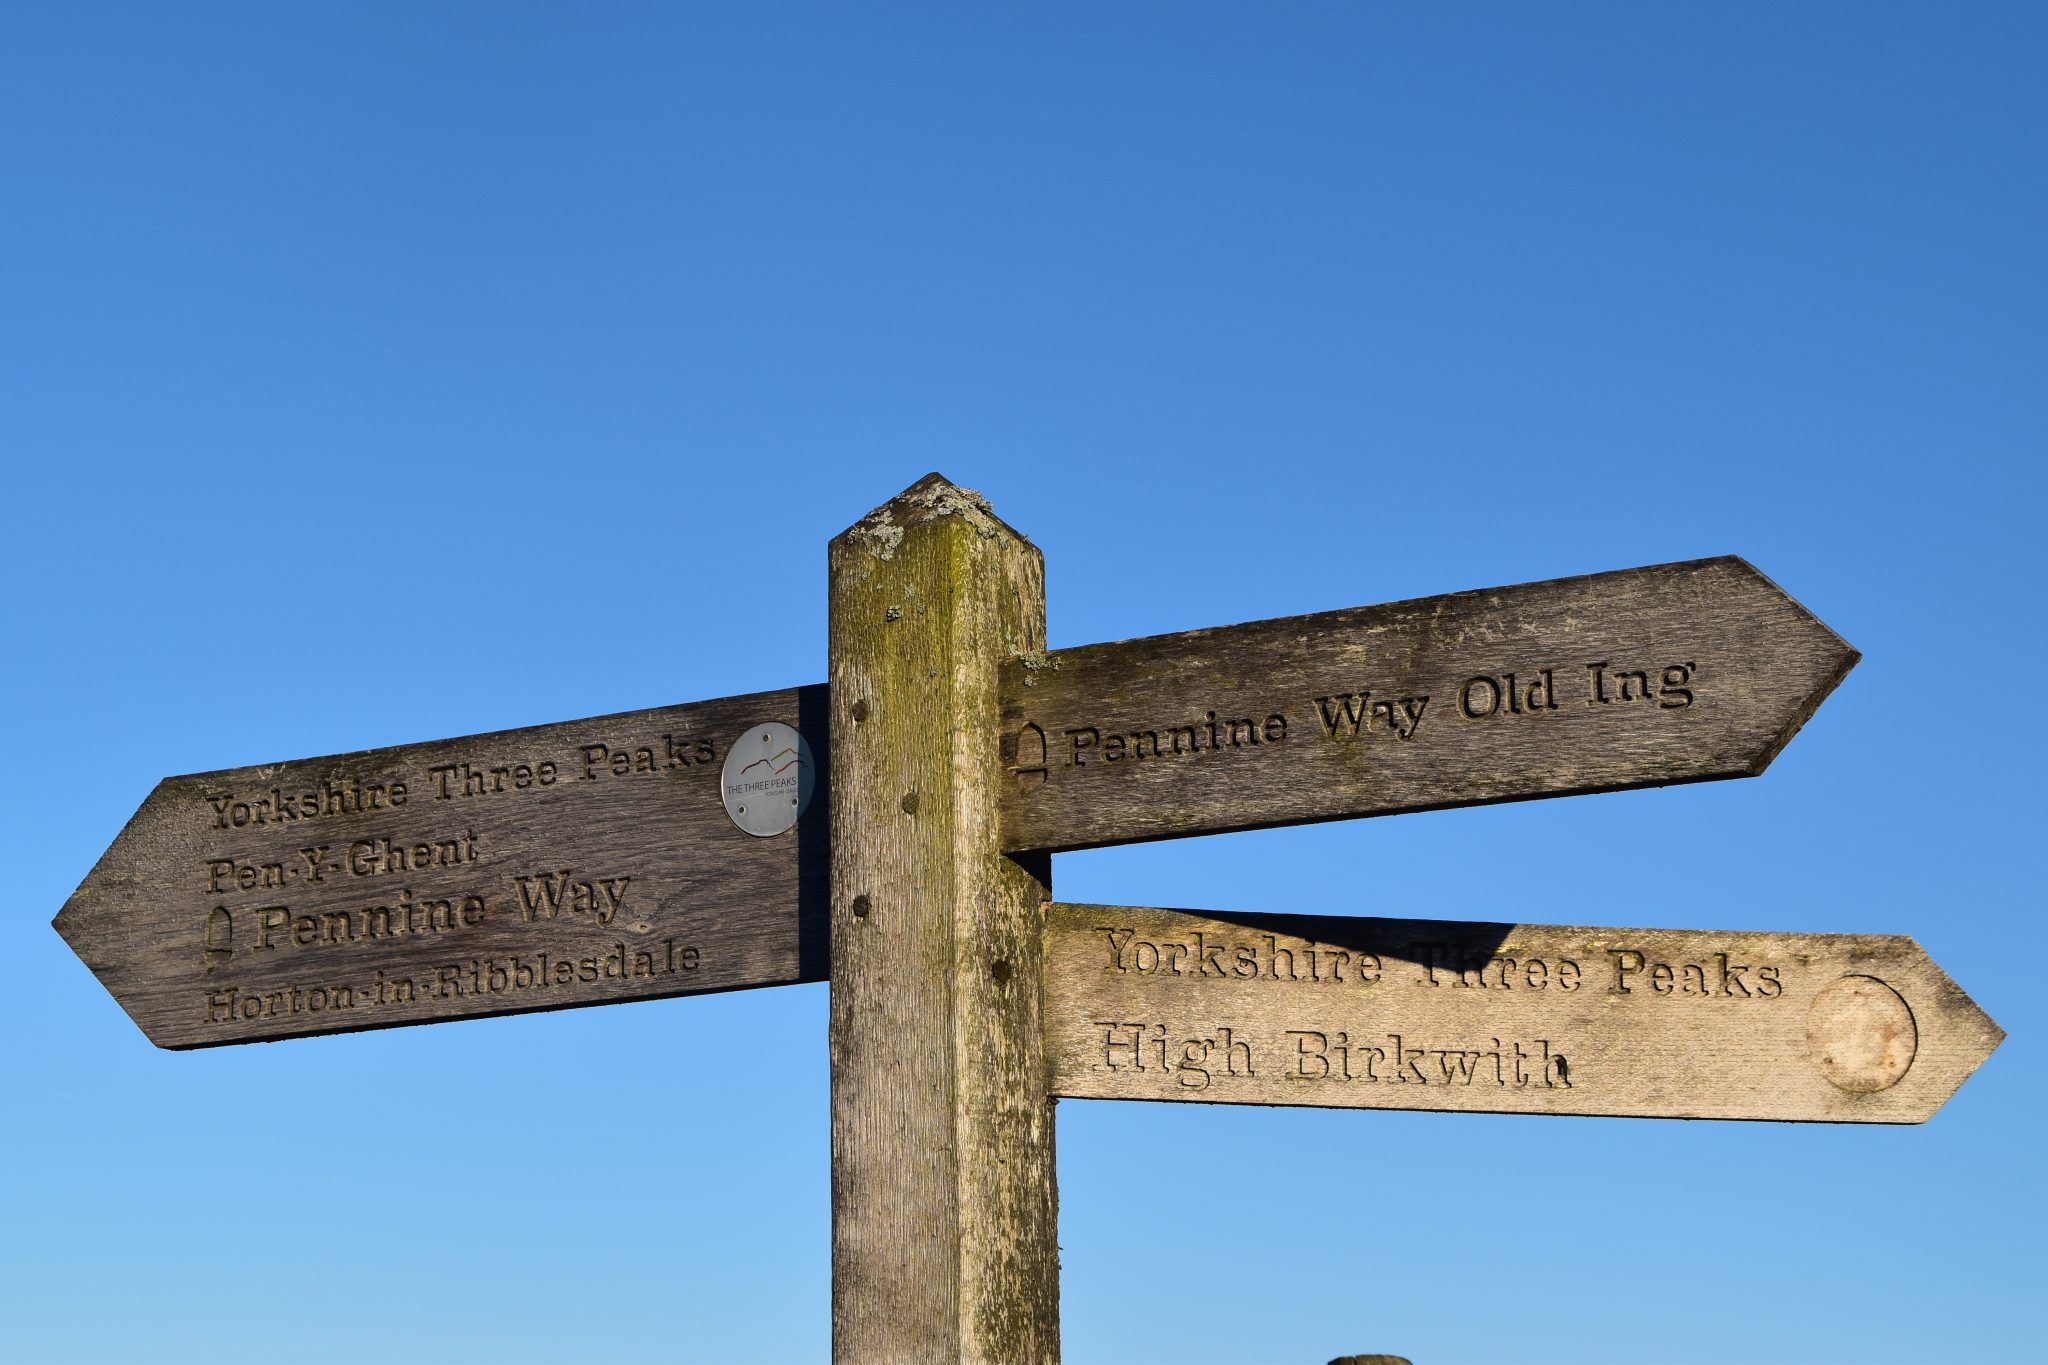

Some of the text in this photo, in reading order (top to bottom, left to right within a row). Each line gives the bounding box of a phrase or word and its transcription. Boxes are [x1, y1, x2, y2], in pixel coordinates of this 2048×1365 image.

[1062, 661, 1697, 768] Pennine Way Old Ing
[205, 733, 716, 830] Yorkshire Three Peaks
[727, 784, 743, 796] THE
[744, 780, 769, 793] THREE
[771, 776, 797, 789] PEAKS
[204, 830, 479, 896] Pen-Y-Ghent
[252, 870, 631, 951] Pennine Way
[203, 938, 701, 1024] Horton-in-Ribblesdale
[1095, 927, 1783, 1000] Yorkshire Three Peaks
[1091, 1021, 1573, 1091] High Birkwith
